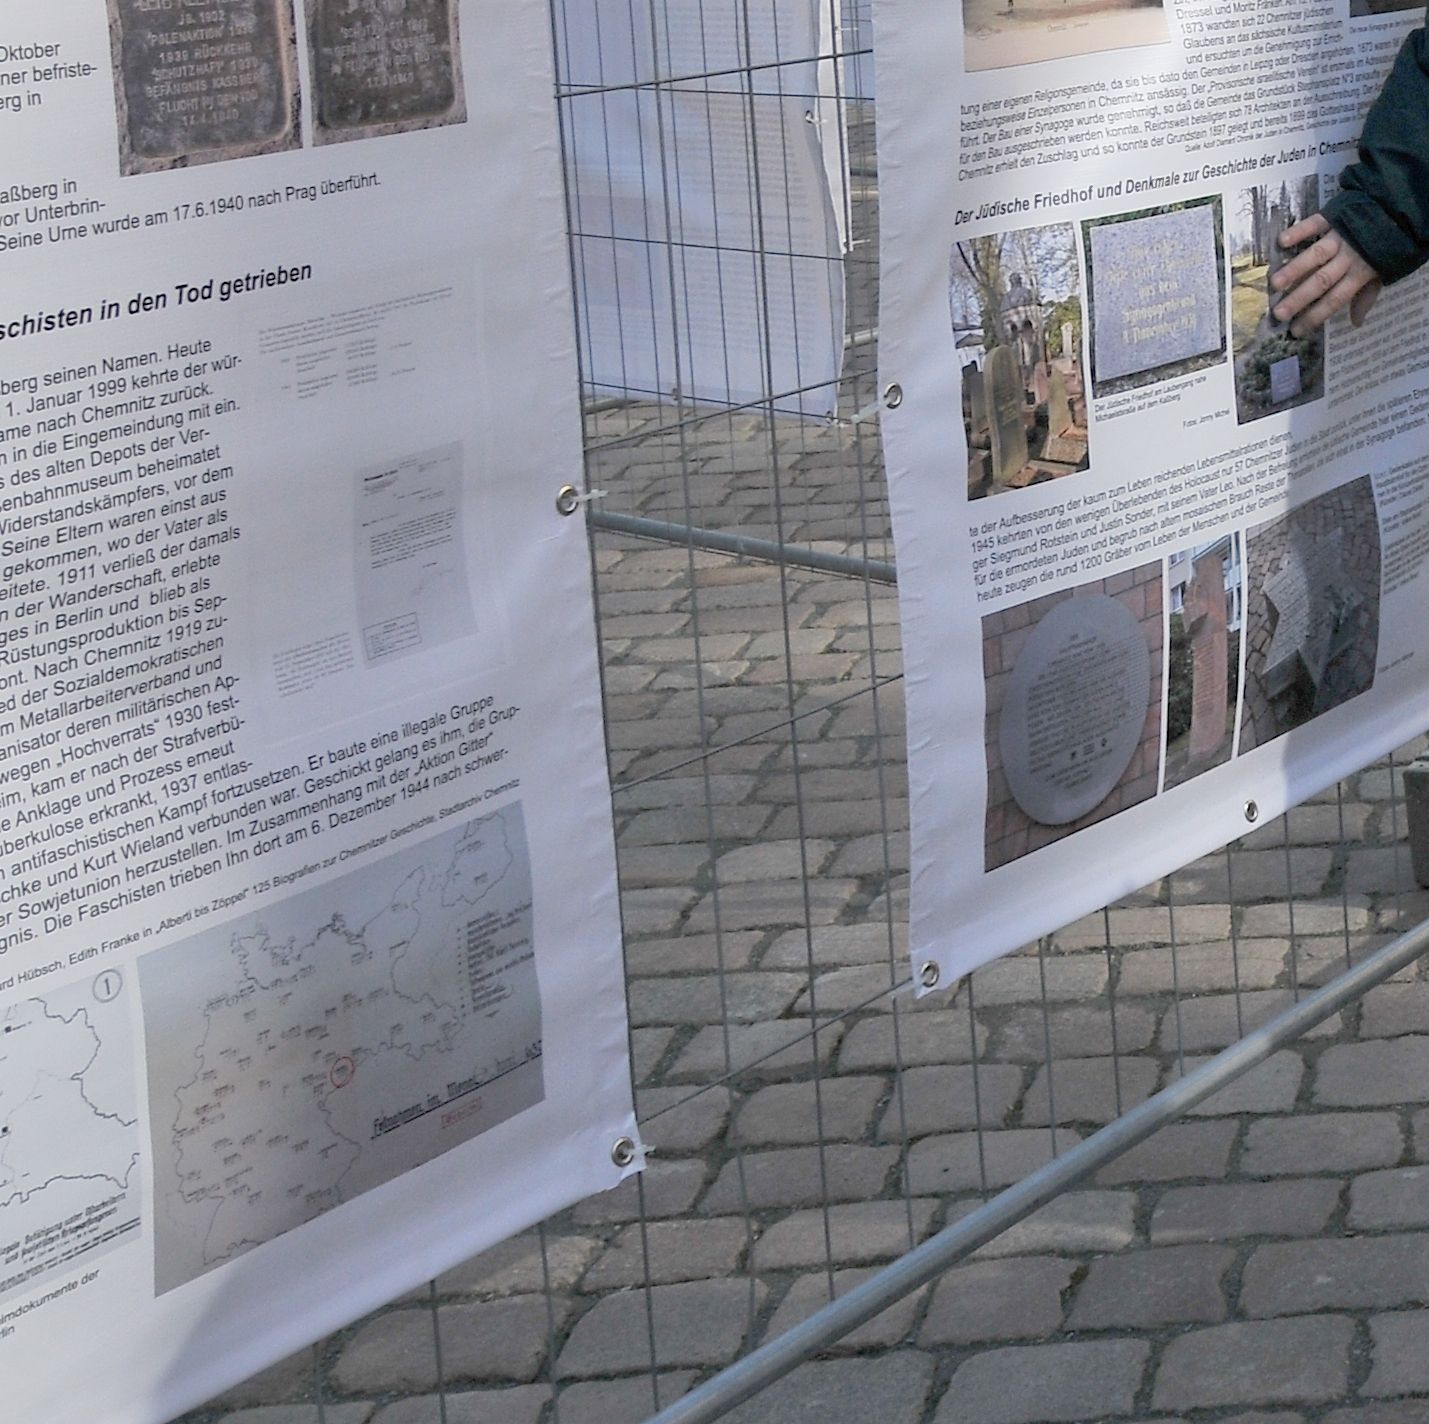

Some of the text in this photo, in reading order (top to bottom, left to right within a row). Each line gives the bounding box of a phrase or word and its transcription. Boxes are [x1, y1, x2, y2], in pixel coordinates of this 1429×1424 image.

[91, 214, 140, 235] wurde
[144, 211, 169, 227] am
[173, 194, 244, 220] 17.6.1940
[248, 189, 282, 208] nach
[285, 185, 317, 202] Prag
[954, 209, 974, 226] Der
[975, 198, 1030, 220] Jüdische
[1033, 185, 1093, 208] Friedhof
[1097, 180, 1122, 199] und
[1125, 171, 1180, 194] Denkmale
[1182, 169, 1200, 184] zur
[1201, 157, 1258, 179] Geschichte
[1259, 153, 1276, 168] der
[1277, 147, 1306, 165] Juden
[100, 299, 120, 321] in
[128, 293, 167, 315] den
[175, 279, 213, 305] Tod
[220, 265, 312, 302] getrieben
[6, 353, 243, 418] 1. Januar 1999 kehrte der wür-
[42, 364, 97, 387] seinen
[101, 351, 163, 373] Namen.
[167, 340, 212, 359] Heute
[10, 695, 495, 876] antifaschistischen Kampf fortzusetzen. Er baute eine illegale Gruppe
